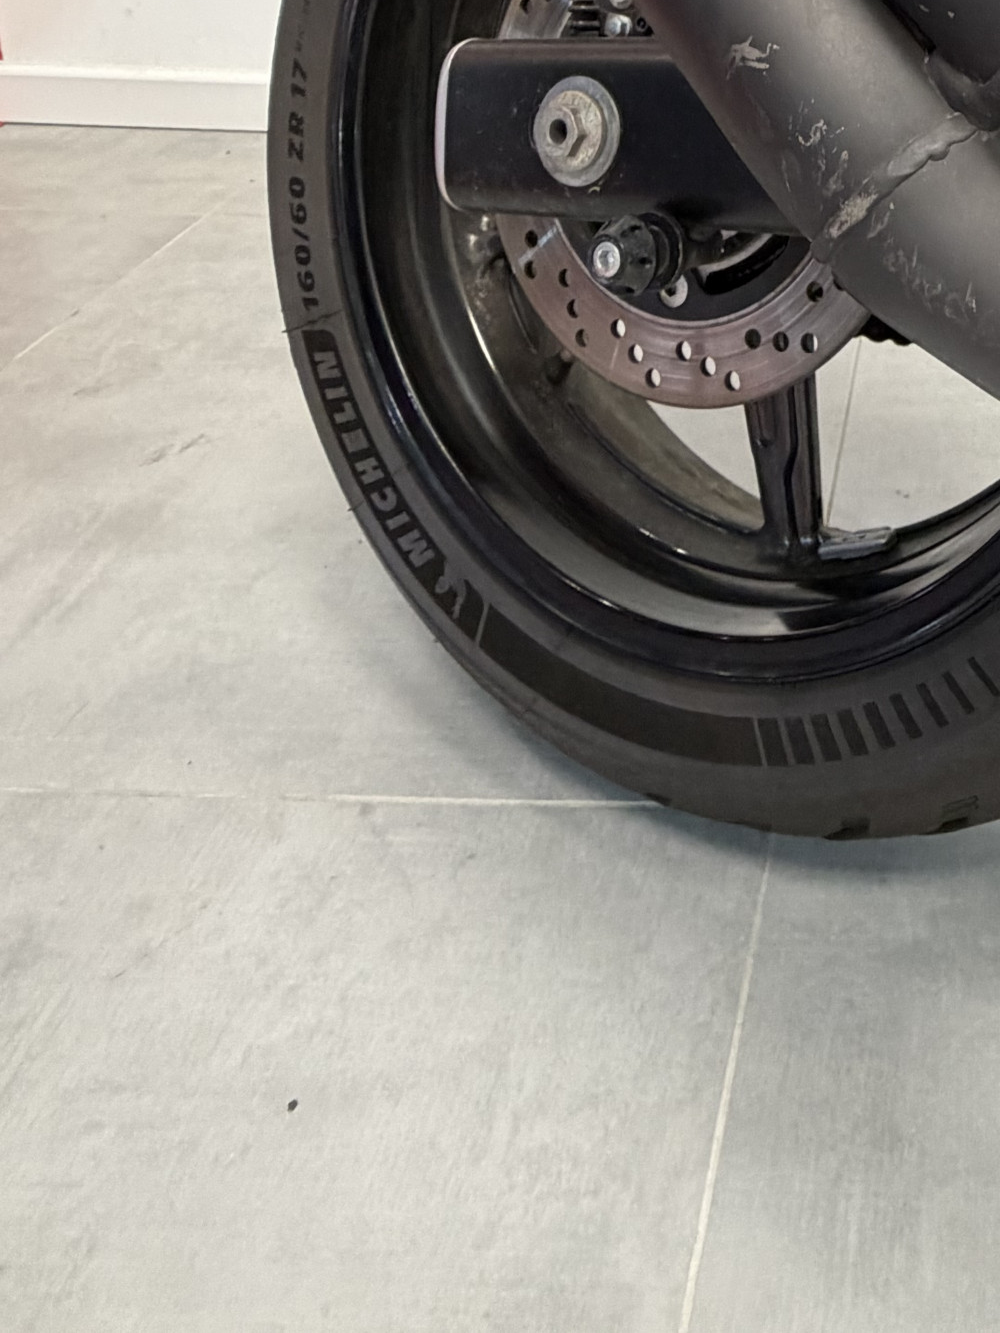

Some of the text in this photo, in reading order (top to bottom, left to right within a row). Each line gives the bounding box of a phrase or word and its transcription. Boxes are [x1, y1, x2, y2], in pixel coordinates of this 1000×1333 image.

[290, 58, 307, 98] 17
[288, 112, 305, 162] ZR
[289, 176, 319, 311] 160/60
[313, 350, 436, 568] MICHELIN
